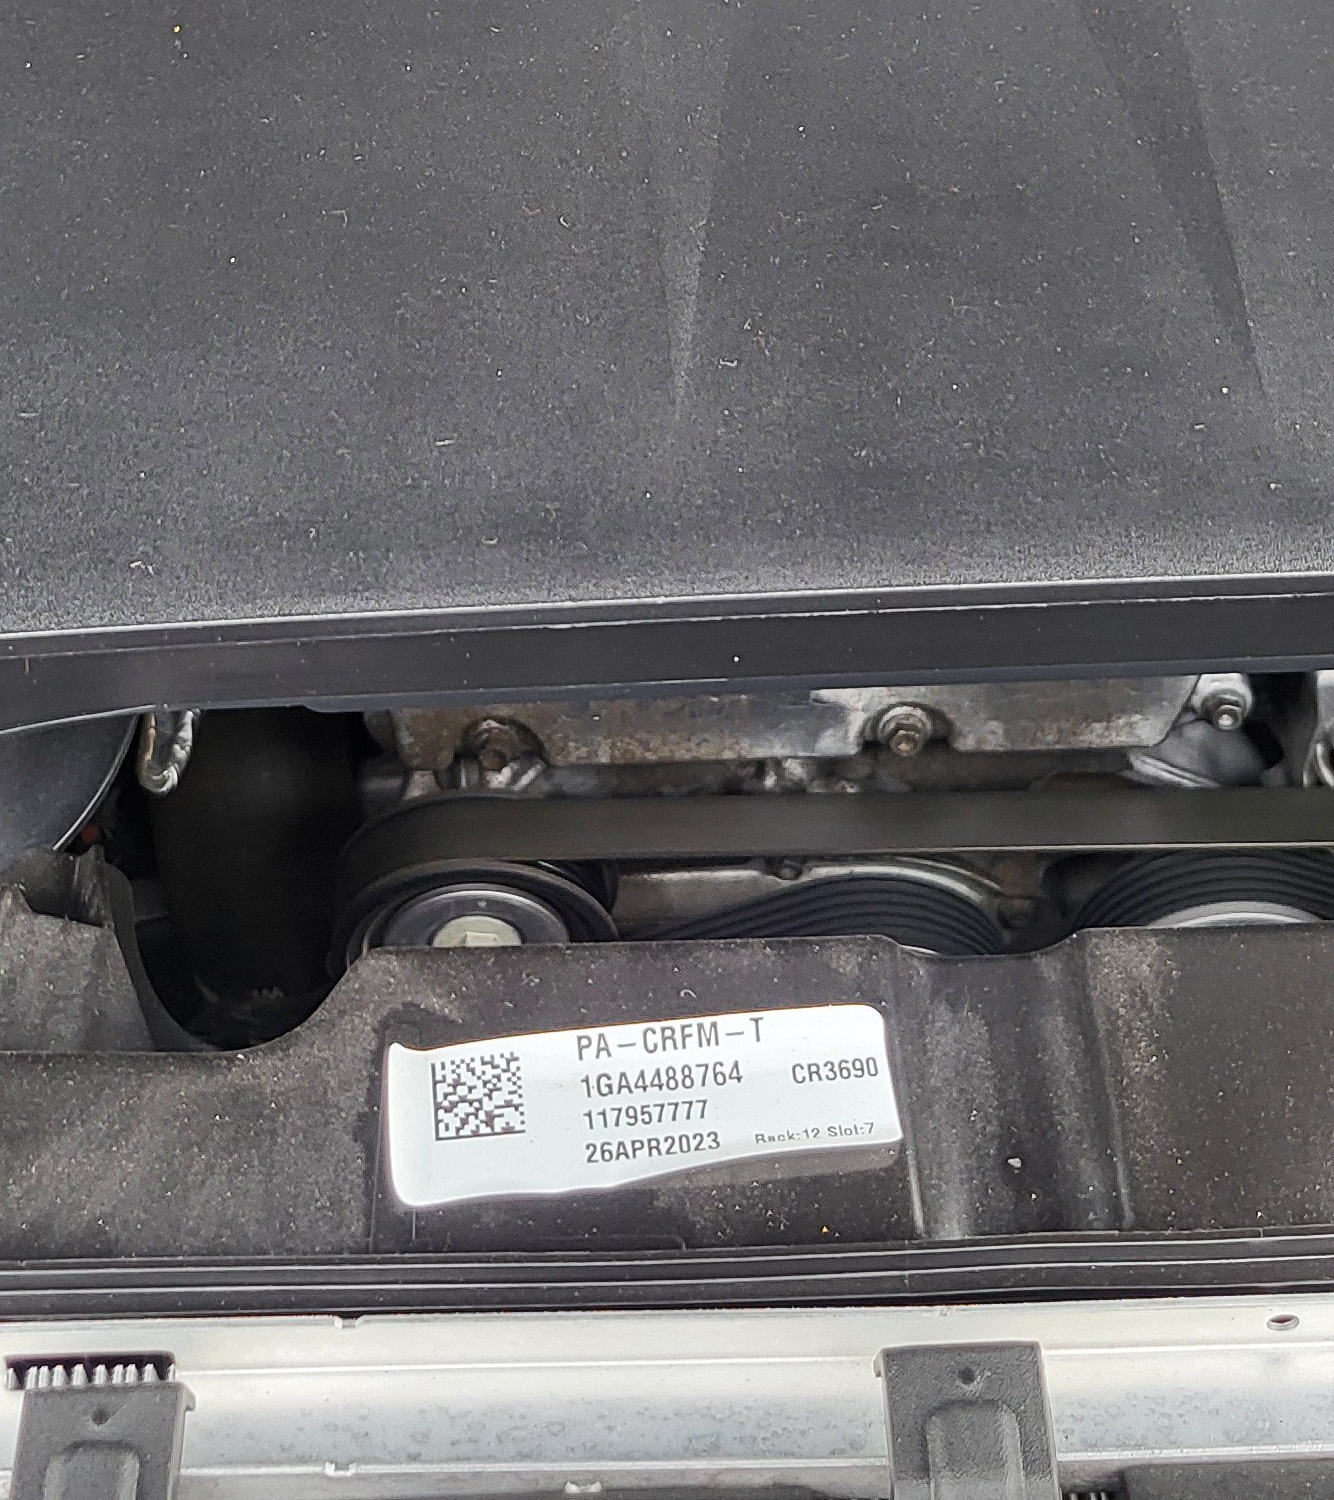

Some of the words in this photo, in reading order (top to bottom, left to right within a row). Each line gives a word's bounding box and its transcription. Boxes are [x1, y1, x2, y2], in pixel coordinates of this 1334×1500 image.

[577, 1016, 764, 1061] PA-CRFM-T
[581, 1060, 743, 1098] 1GA4488764
[792, 1056, 879, 1085] CR3690
[584, 1099, 708, 1130] 117957777
[585, 1131, 721, 1163] 26APR2023
[755, 1127, 820, 1144] Rack:12
[827, 1122, 874, 1137] Slot:7
